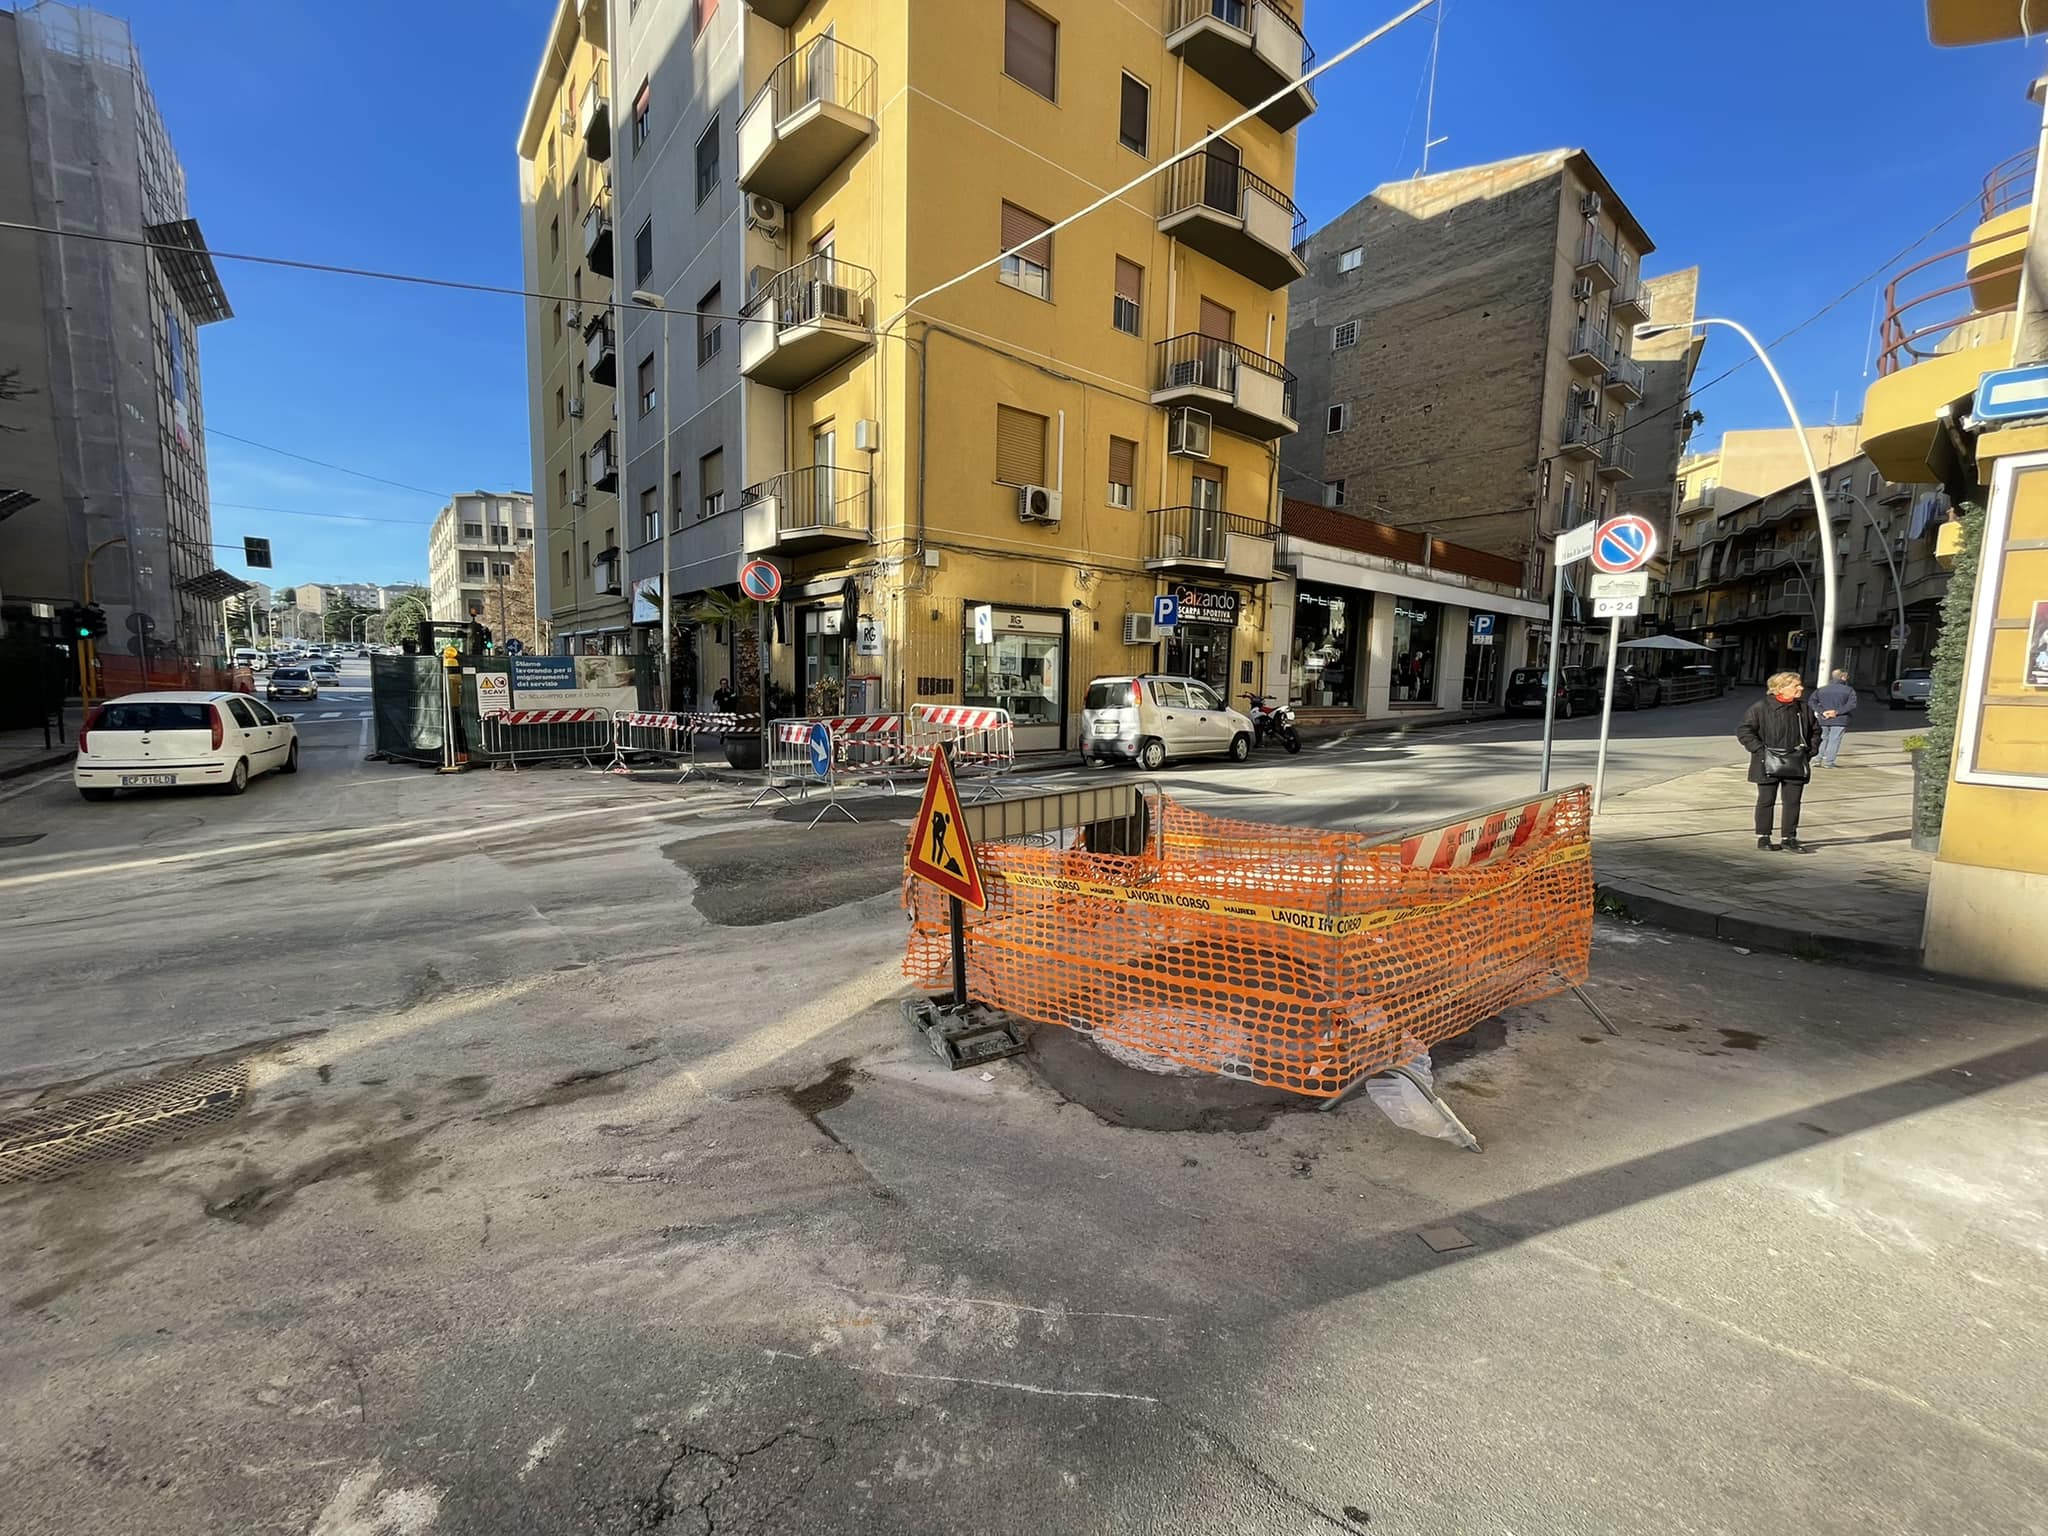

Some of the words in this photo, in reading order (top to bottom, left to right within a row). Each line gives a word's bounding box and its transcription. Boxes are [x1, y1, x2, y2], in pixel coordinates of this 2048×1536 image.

[1175, 586, 1235, 610] Calzando
[1158, 598, 1174, 623] P
[863, 626, 876, 642] RG
[1476, 617, 1492, 633] P
[1053, 880, 1081, 892] CORSO
[1125, 889, 1160, 904] LAVORI
[1161, 895, 1173, 904] IN
[1174, 896, 1210, 911] CORSO
[1224, 905, 1257, 916] MAURER
[1271, 909, 1315, 929] LAVORI
[1318, 918, 1333, 932] IN
[1336, 916, 1362, 934] CORSO
